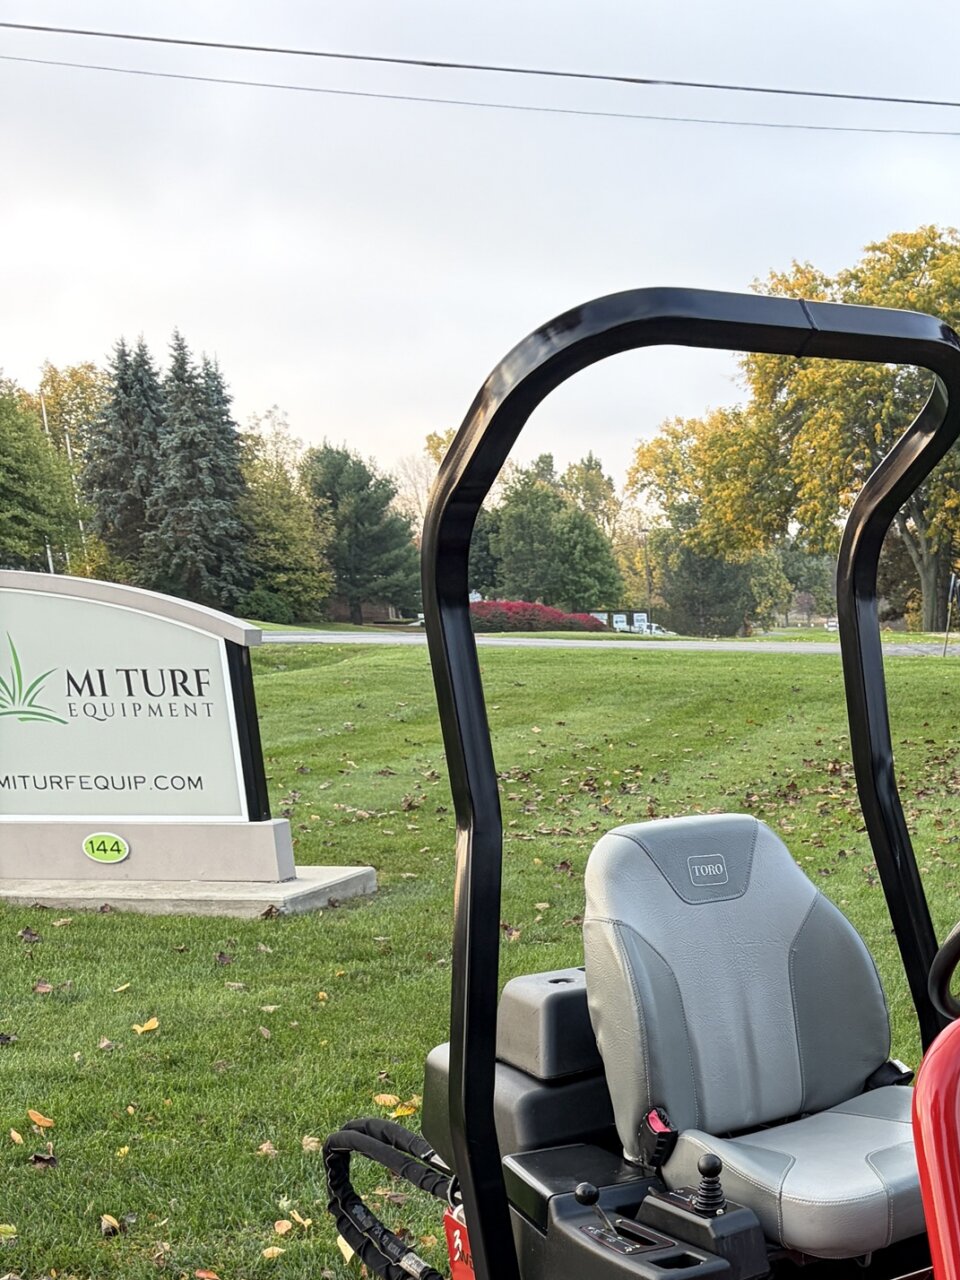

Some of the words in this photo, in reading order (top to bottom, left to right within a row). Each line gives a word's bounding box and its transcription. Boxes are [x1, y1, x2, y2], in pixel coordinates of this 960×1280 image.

[66, 668, 109, 697] MI
[115, 668, 210, 698] TURF
[68, 702, 214, 722] EQUIPMENT
[88, 840, 122, 855] 144
[691, 863, 724, 877] TORO
